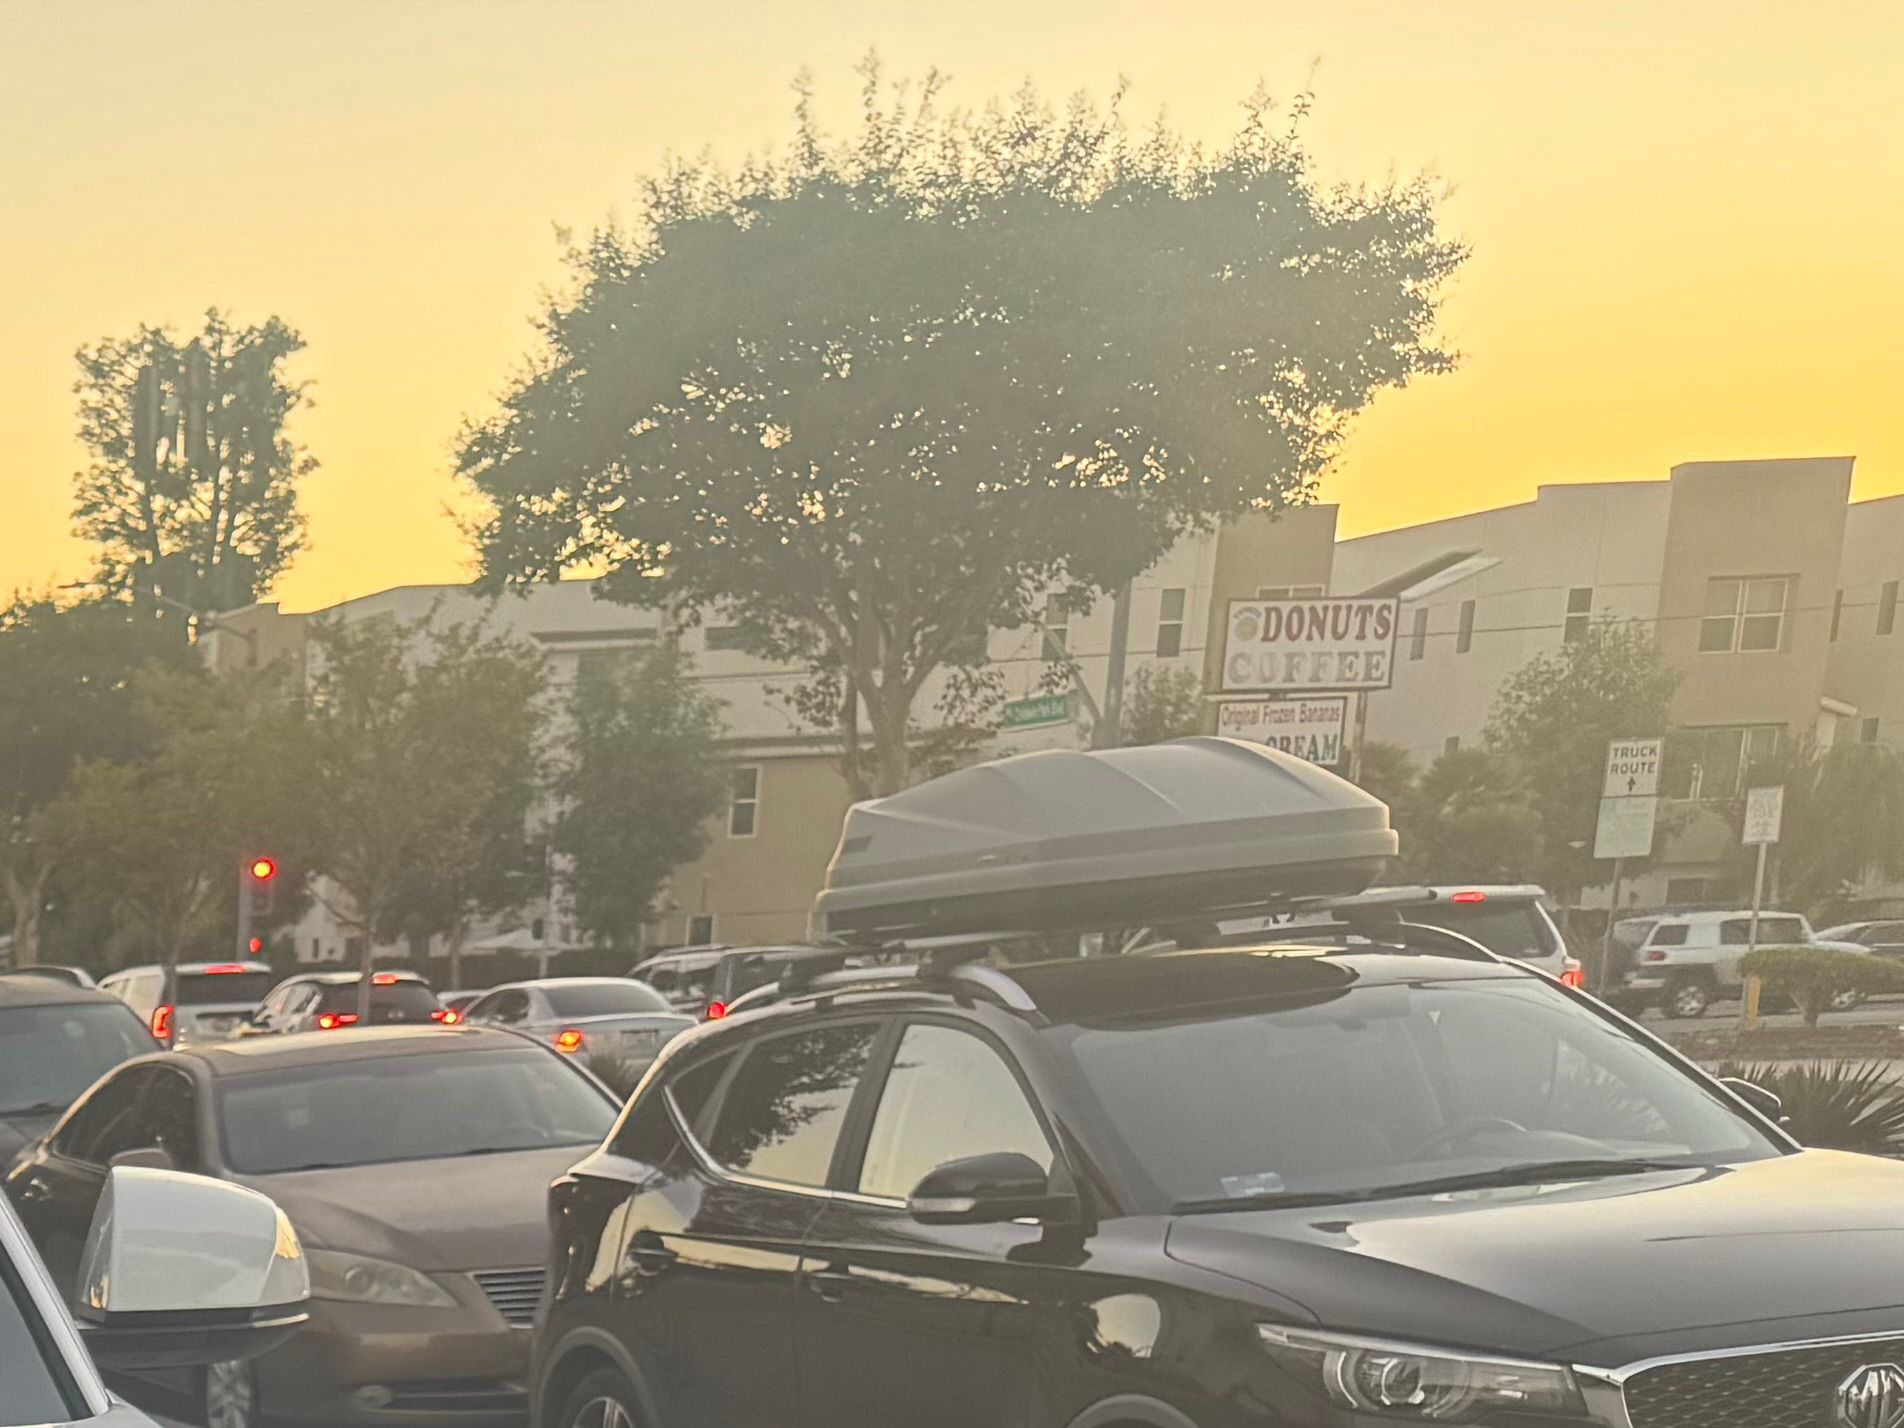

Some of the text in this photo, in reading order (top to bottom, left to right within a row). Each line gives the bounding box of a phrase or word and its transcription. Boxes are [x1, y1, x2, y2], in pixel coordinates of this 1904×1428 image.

[1260, 603, 1392, 642] DONUTS
[1227, 650, 1387, 684] COFFEE
[1221, 706, 1259, 731] Original
[1613, 746, 1658, 759] TRUCK
[1610, 761, 1656, 775] ROUTE
